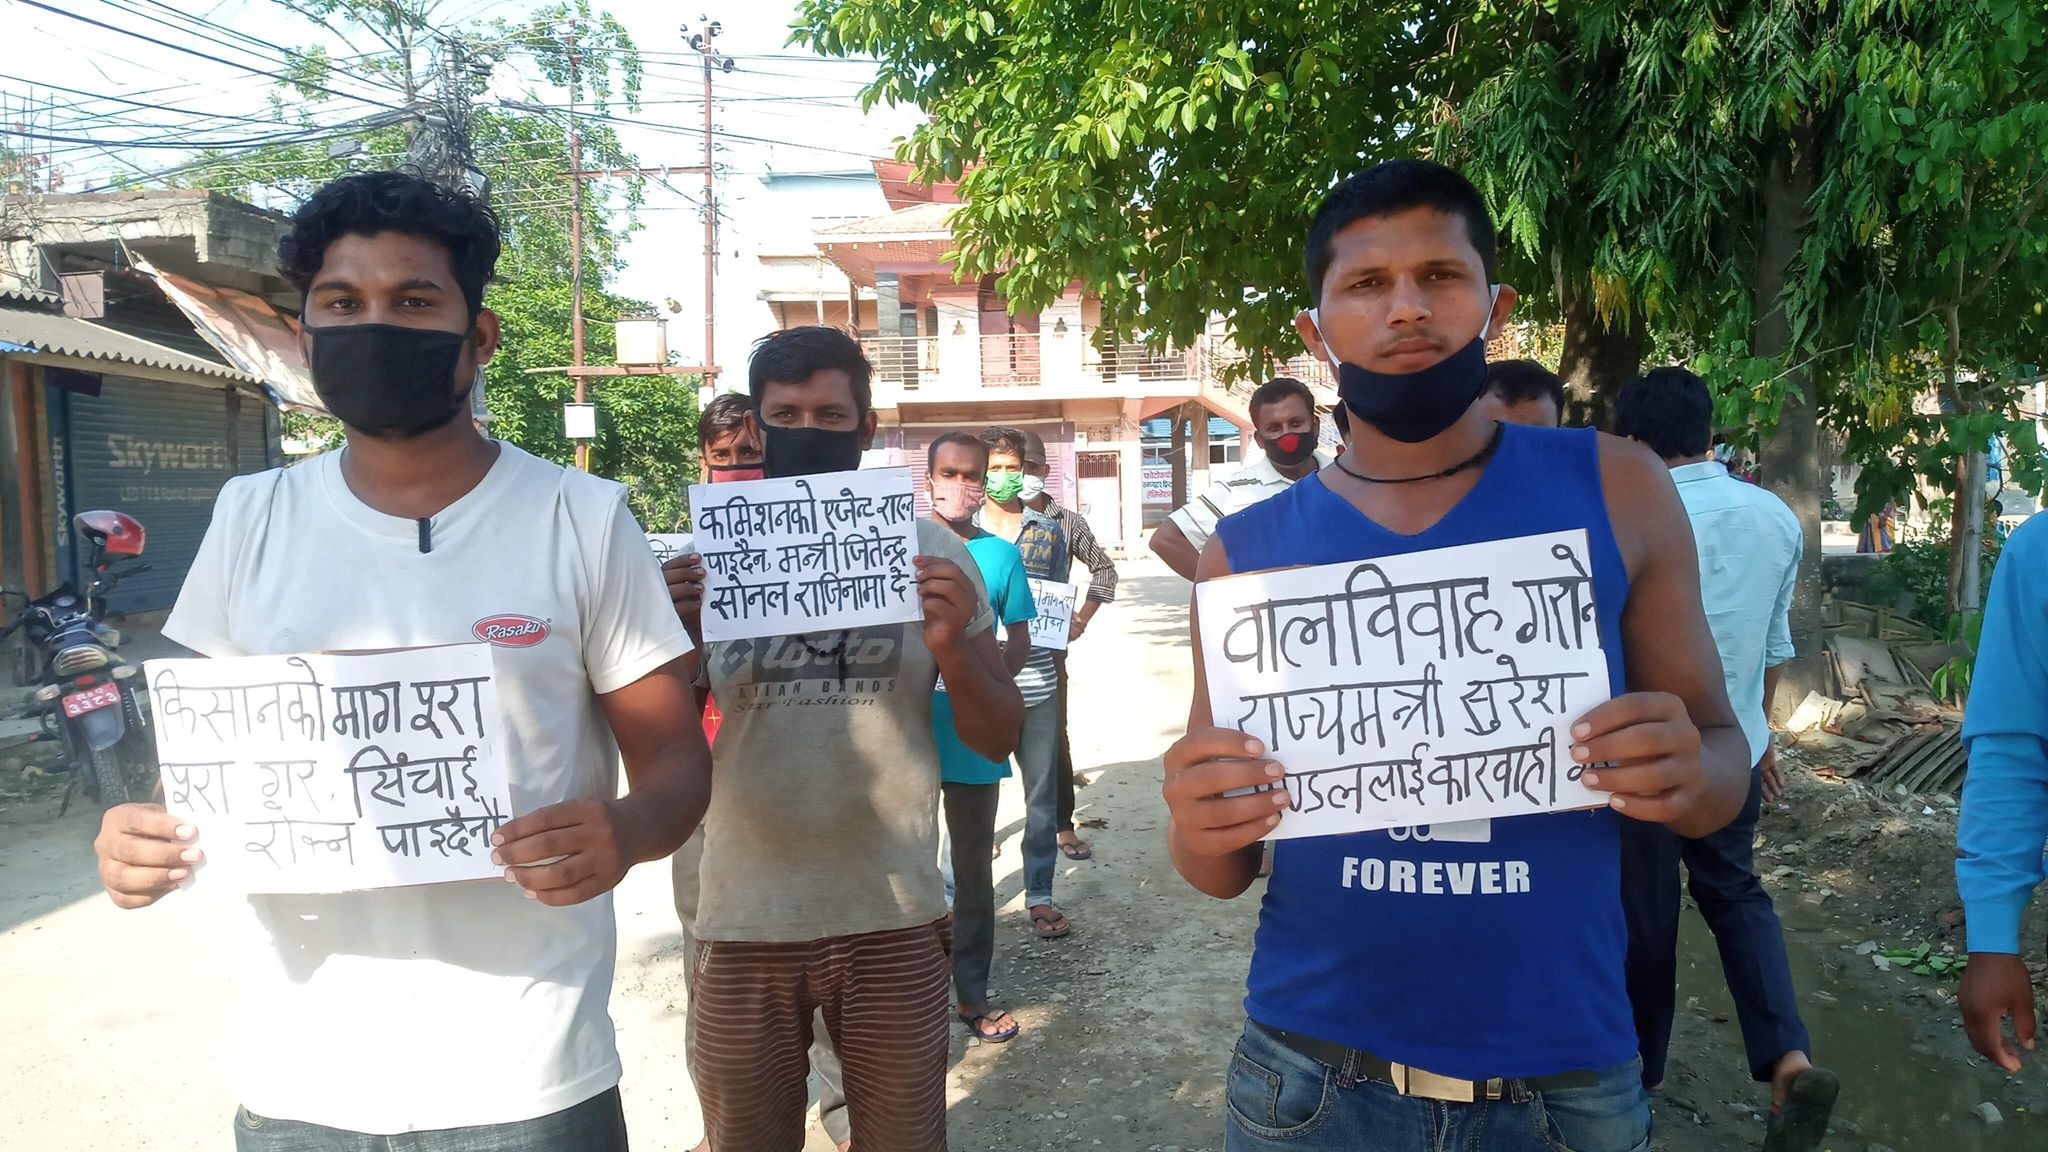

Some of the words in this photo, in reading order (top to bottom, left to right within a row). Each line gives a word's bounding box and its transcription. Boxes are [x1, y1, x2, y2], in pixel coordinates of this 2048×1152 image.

[699, 480, 816, 540] कमिशनको
[776, 532, 840, 575] मन्त्री
[710, 573, 790, 620] सोनल
[794, 571, 886, 618] राजिनामा
[485, 621, 542, 640] Rasaki
[155, 658, 325, 742] किसानको
[332, 681, 401, 740] माग
[410, 676, 491, 739] पूरा
[1459, 654, 1590, 737] सुरेश
[1341, 856, 1531, 895] FOREVER
